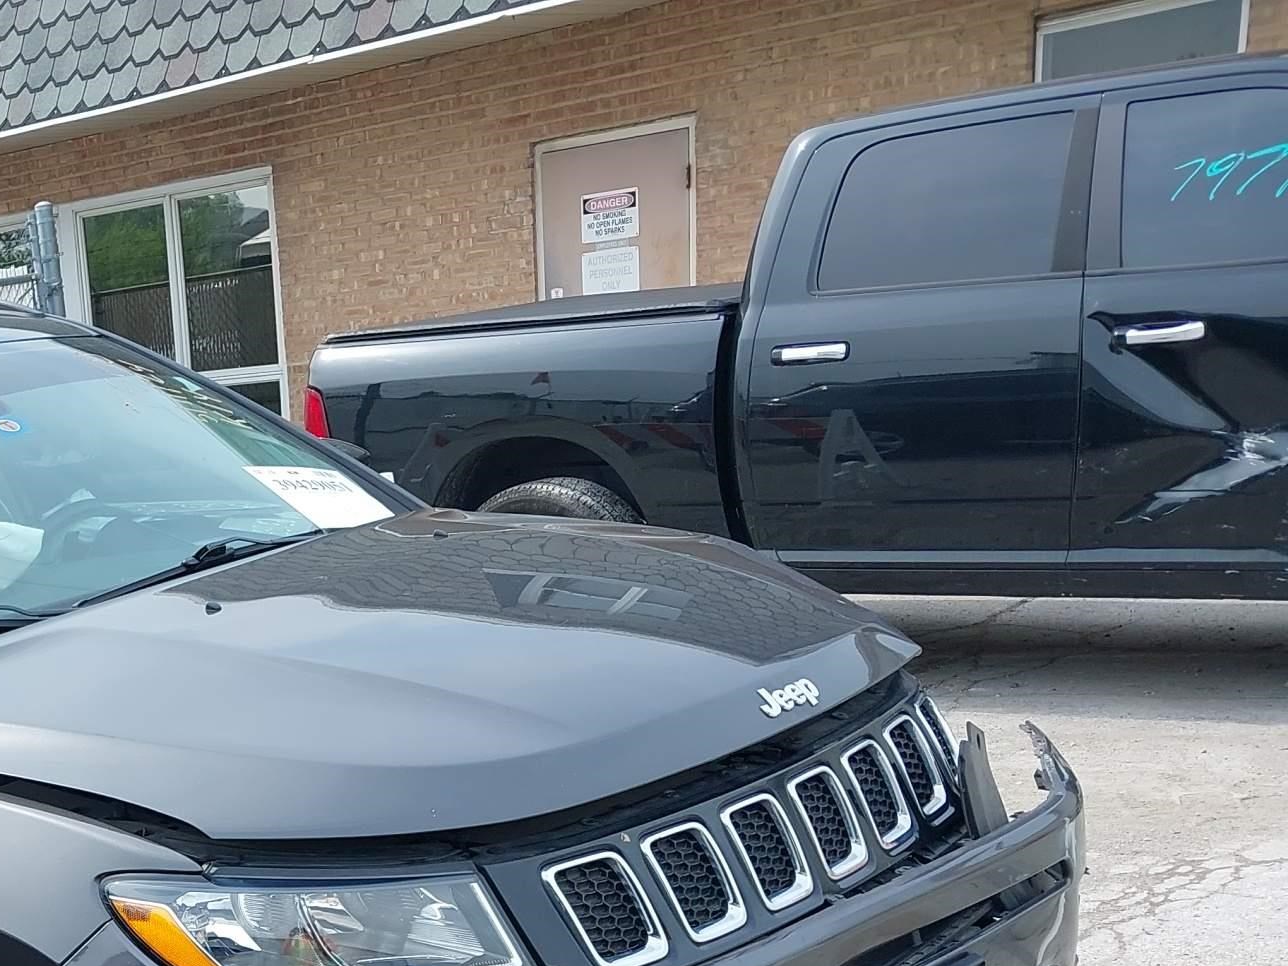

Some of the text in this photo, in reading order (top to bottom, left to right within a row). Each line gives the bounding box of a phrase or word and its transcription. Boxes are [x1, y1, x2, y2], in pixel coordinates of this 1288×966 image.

[590, 197, 628, 210] DANGER
[602, 210, 626, 220] SMOKING
[587, 216, 633, 230] NO OPEN FLAMES
[595, 226, 625, 237] NO SPARKS
[588, 252, 633, 265] AUTHORIZED
[589, 266, 633, 280] PERSONNEL
[602, 279, 621, 291] ONLY
[757, 678, 819, 717] Jeep
